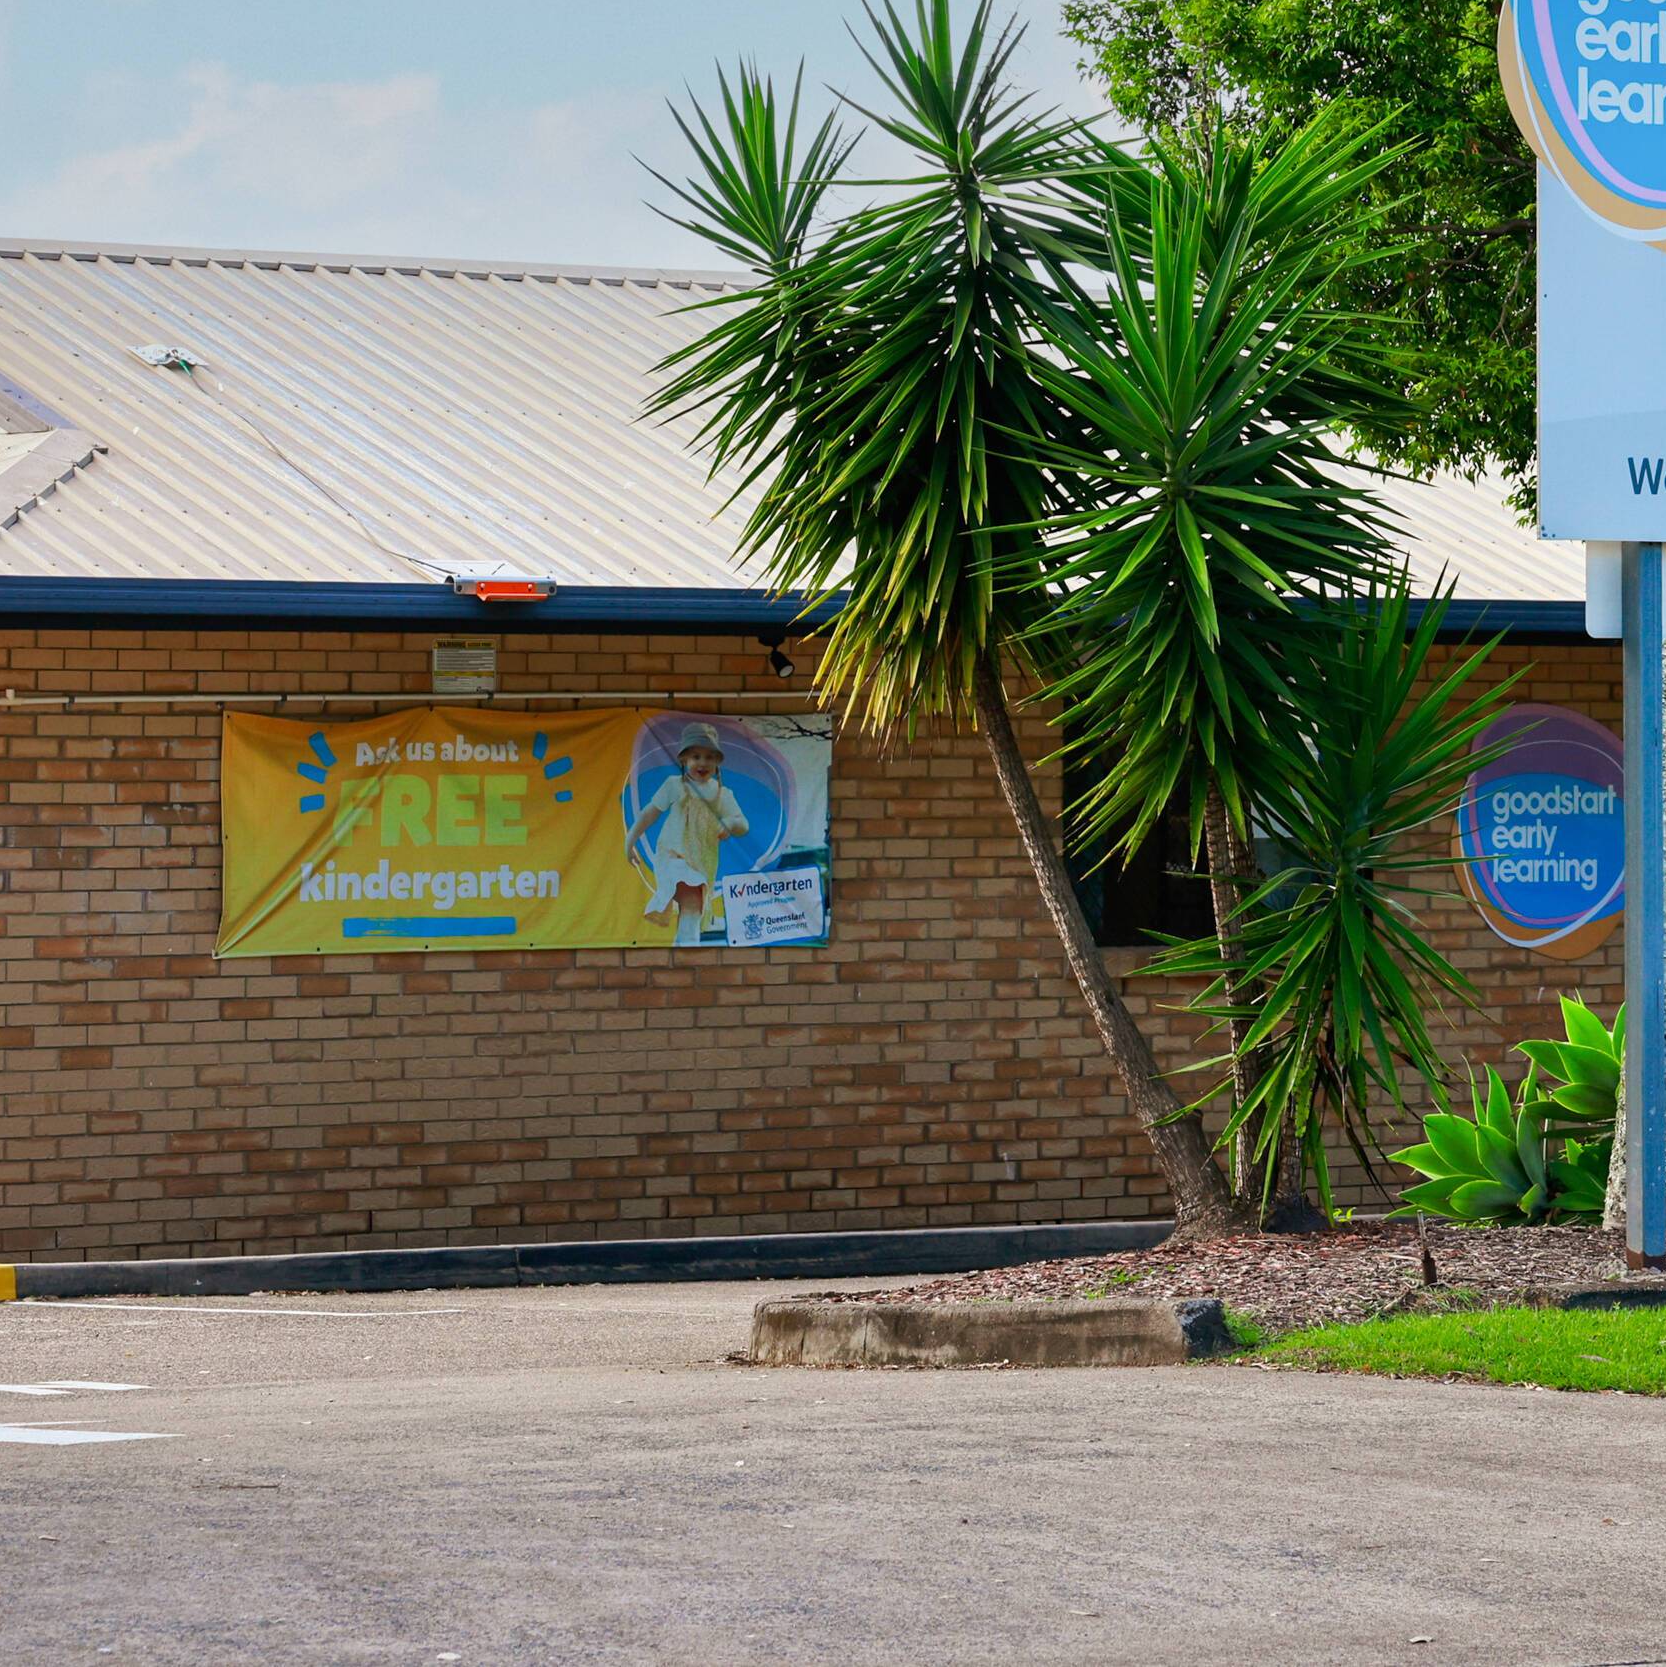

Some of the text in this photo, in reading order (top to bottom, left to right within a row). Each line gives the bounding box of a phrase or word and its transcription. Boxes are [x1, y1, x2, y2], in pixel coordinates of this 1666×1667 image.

[355, 734, 520, 766] Ask us about
[332, 774, 528, 847] FREE
[1492, 784, 1617, 825] goodstart
[1491, 819, 1559, 857] early
[299, 859, 561, 911] kindergarten
[1492, 852, 1598, 891] learning
